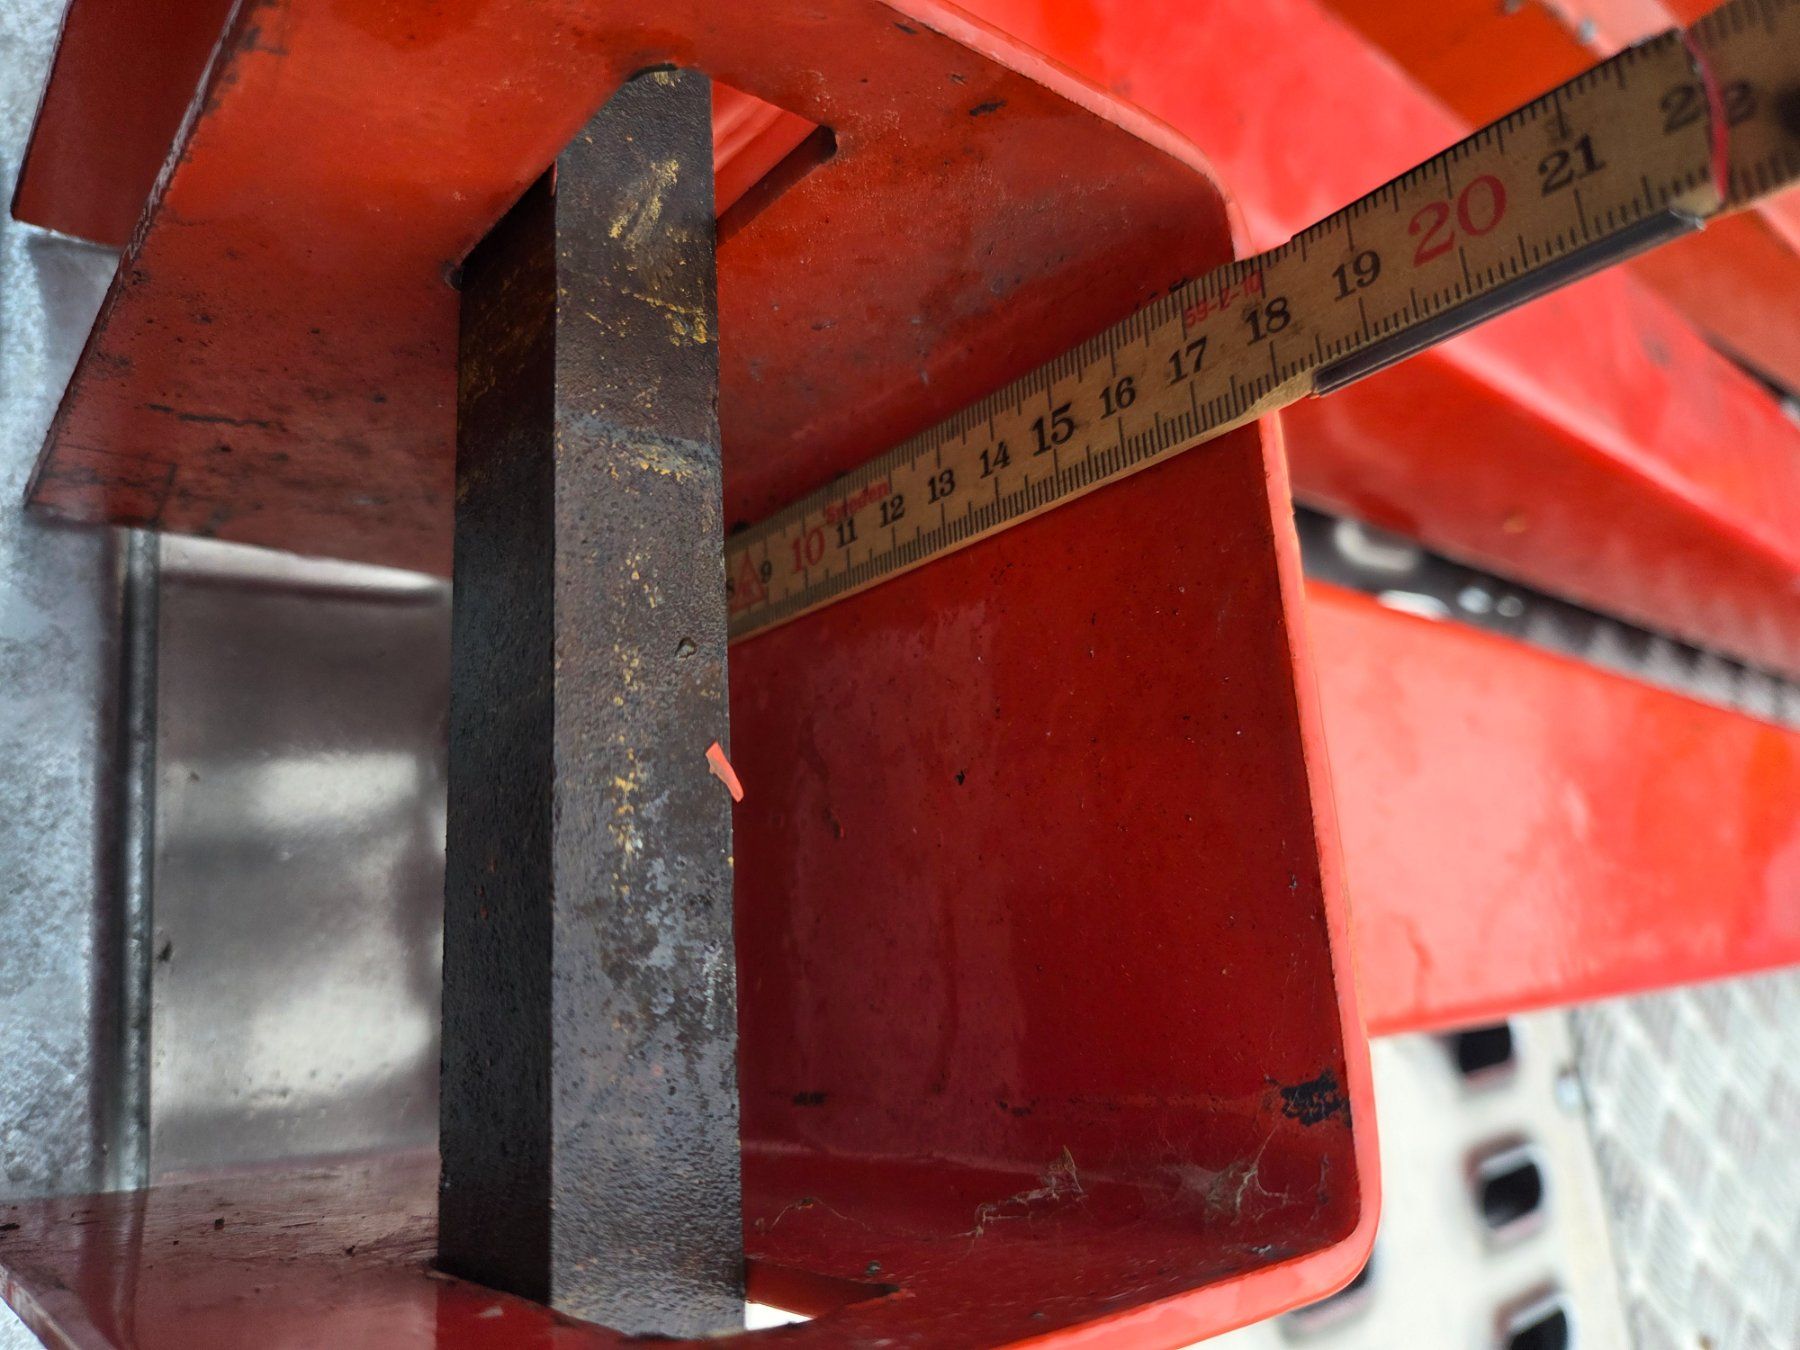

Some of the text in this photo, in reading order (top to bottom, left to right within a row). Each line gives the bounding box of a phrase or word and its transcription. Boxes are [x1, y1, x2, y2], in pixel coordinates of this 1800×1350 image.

[760, 560, 773, 584] 9
[791, 528, 826, 575] 10
[836, 518, 858, 548] 11
[879, 494, 906, 528] 12
[927, 469, 956, 504] 13
[979, 441, 1010, 479] 14
[1031, 403, 1076, 456] 15
[1099, 376, 1137, 419] 16
[1167, 337, 1208, 386] 17
[1243, 296, 1291, 346] 18
[1331, 249, 1381, 300] 19
[1408, 175, 1507, 267] 20
[1539, 133, 1607, 197] 21
